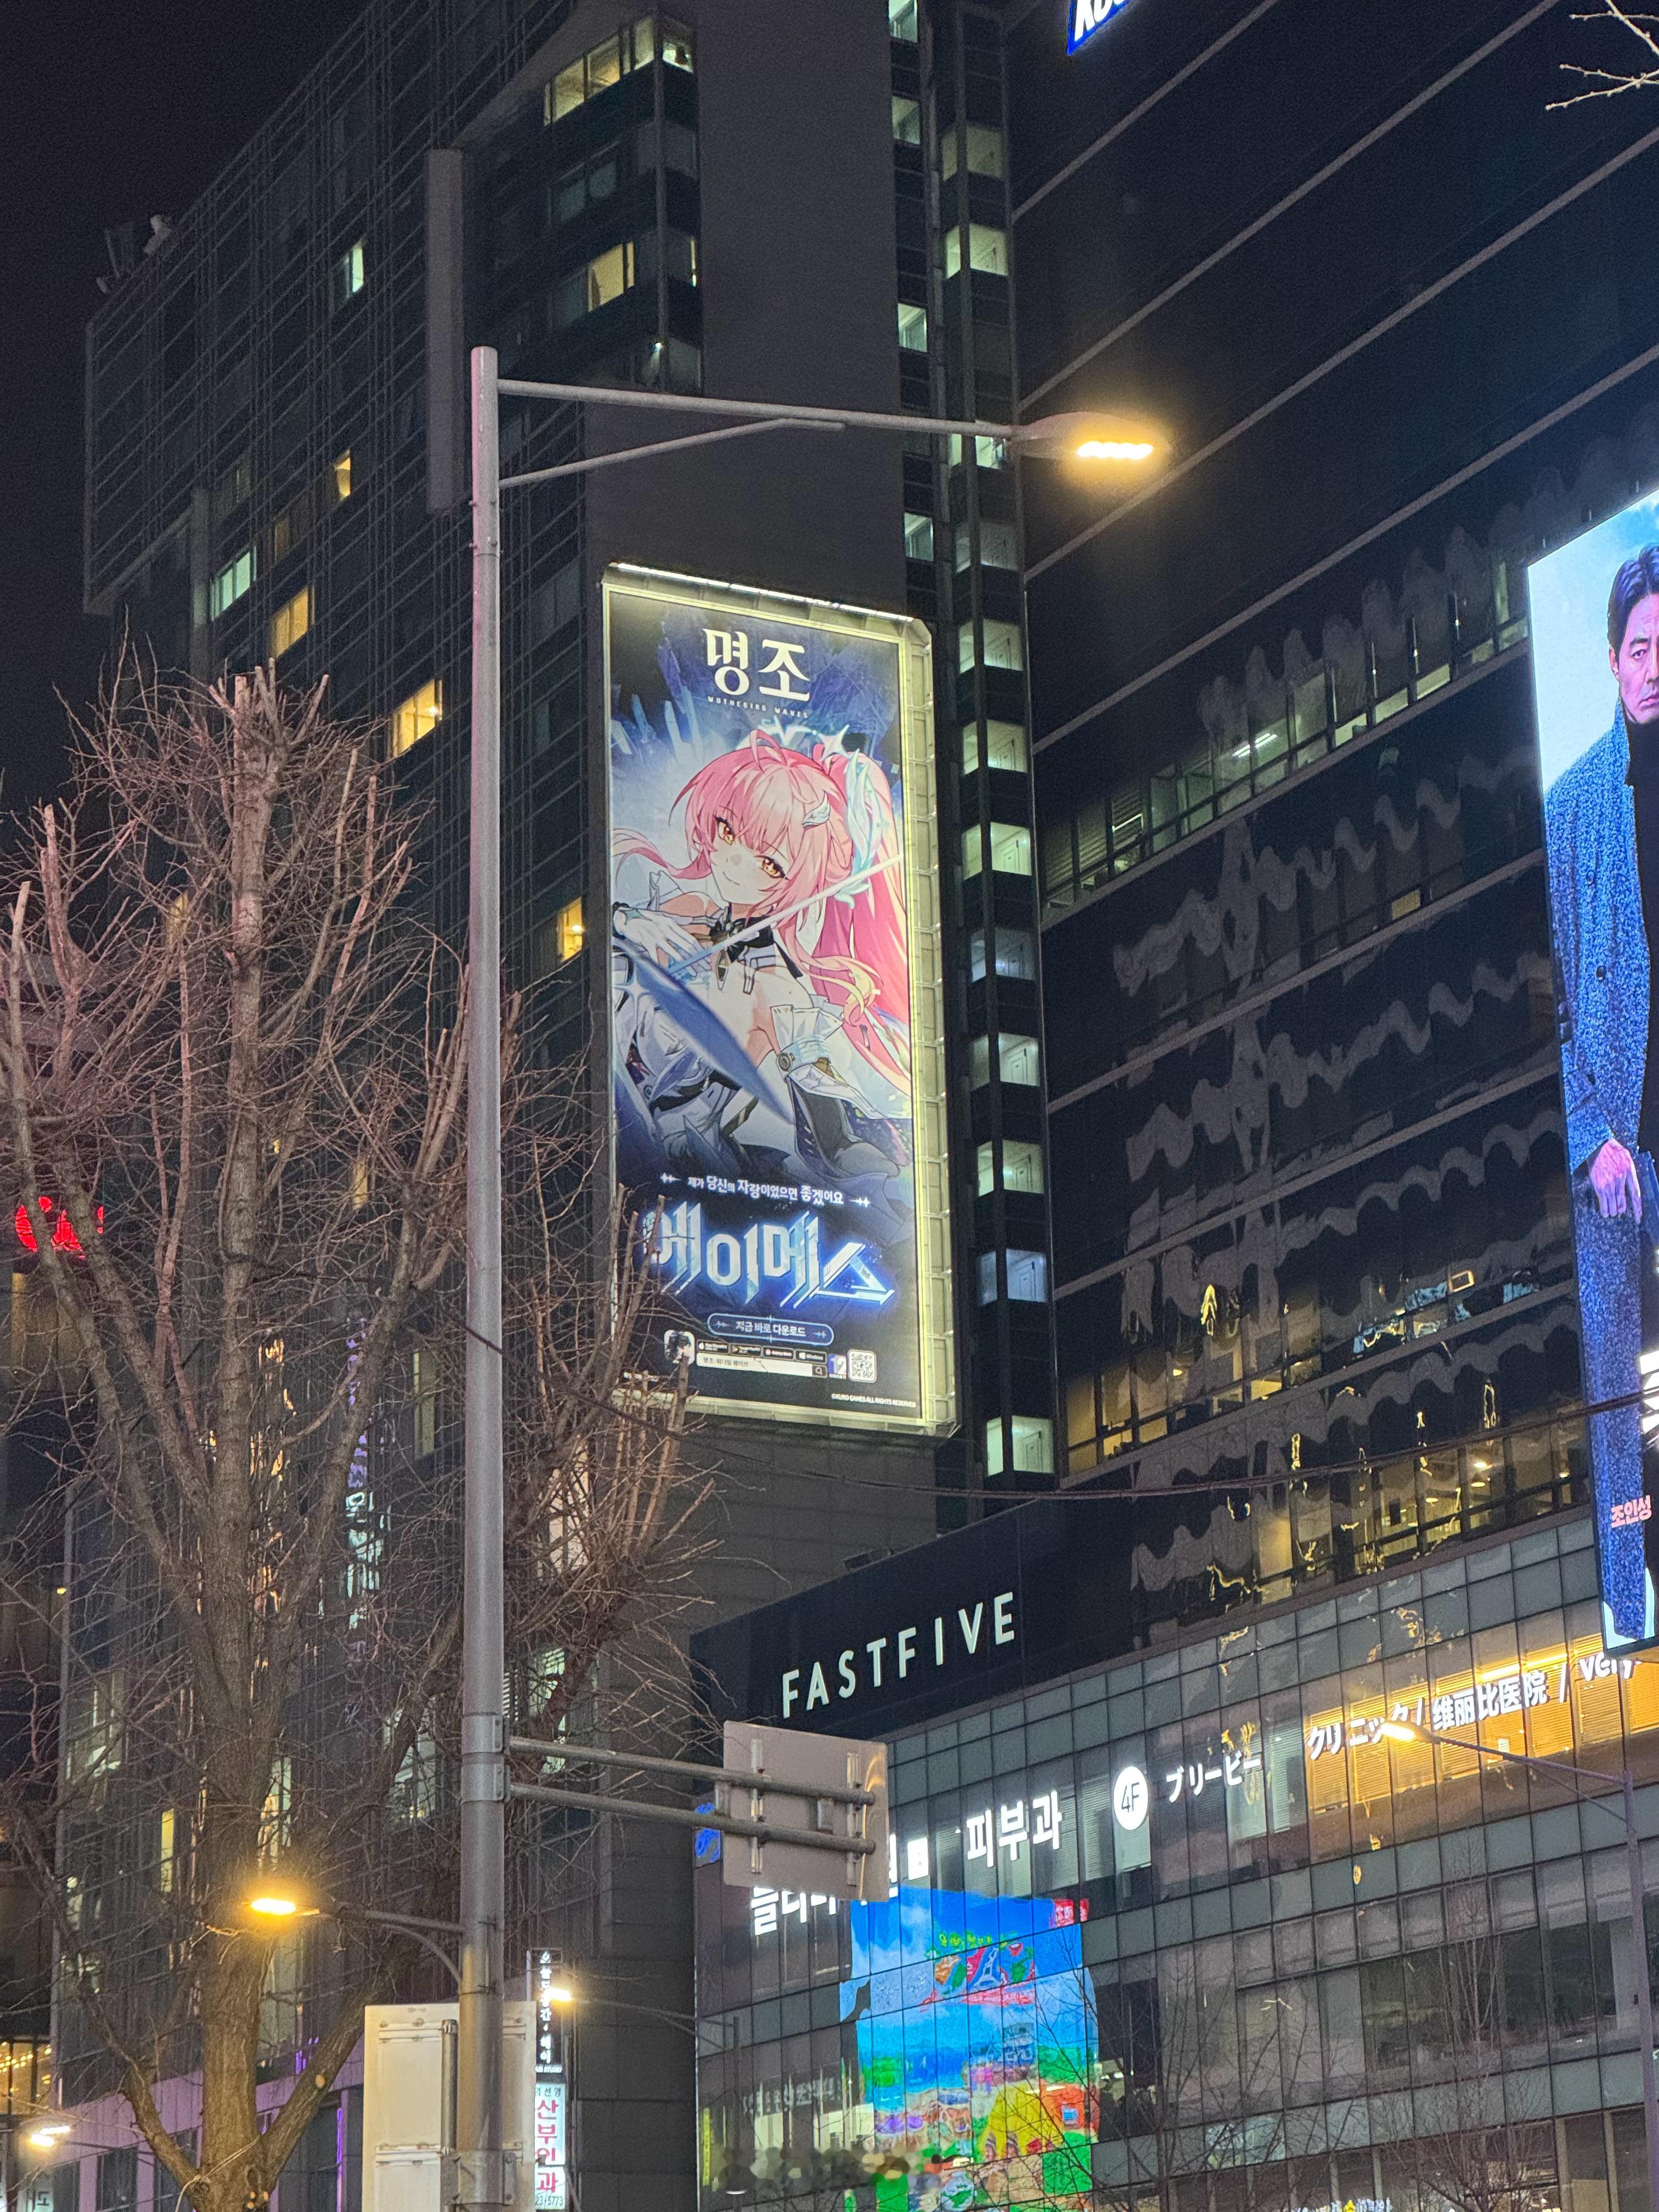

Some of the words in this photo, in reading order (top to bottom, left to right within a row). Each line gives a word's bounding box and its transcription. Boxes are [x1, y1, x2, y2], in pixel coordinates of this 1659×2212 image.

[702, 628, 810, 702] 명조
[774, 707, 808, 719] WAVES
[706, 1175, 735, 1194] 당신의
[737, 1178, 798, 1200] 자랑이었으면
[800, 1184, 844, 1206] 좋겠어요
[754, 1323, 771, 1334] 바로
[772, 1324, 807, 1338] 다운로드
[1610, 1494, 1652, 1528] 조인성
[782, 1592, 1015, 1719] FASTFIVE
[1166, 1751, 1261, 1803] ブリービー
[1432, 1669, 1548, 1731] 维丽比医院
[1121, 1781, 1140, 1813] 4F
[966, 1790, 1063, 1868] 피부과
[535, 2099, 560, 2193] 산부인과
